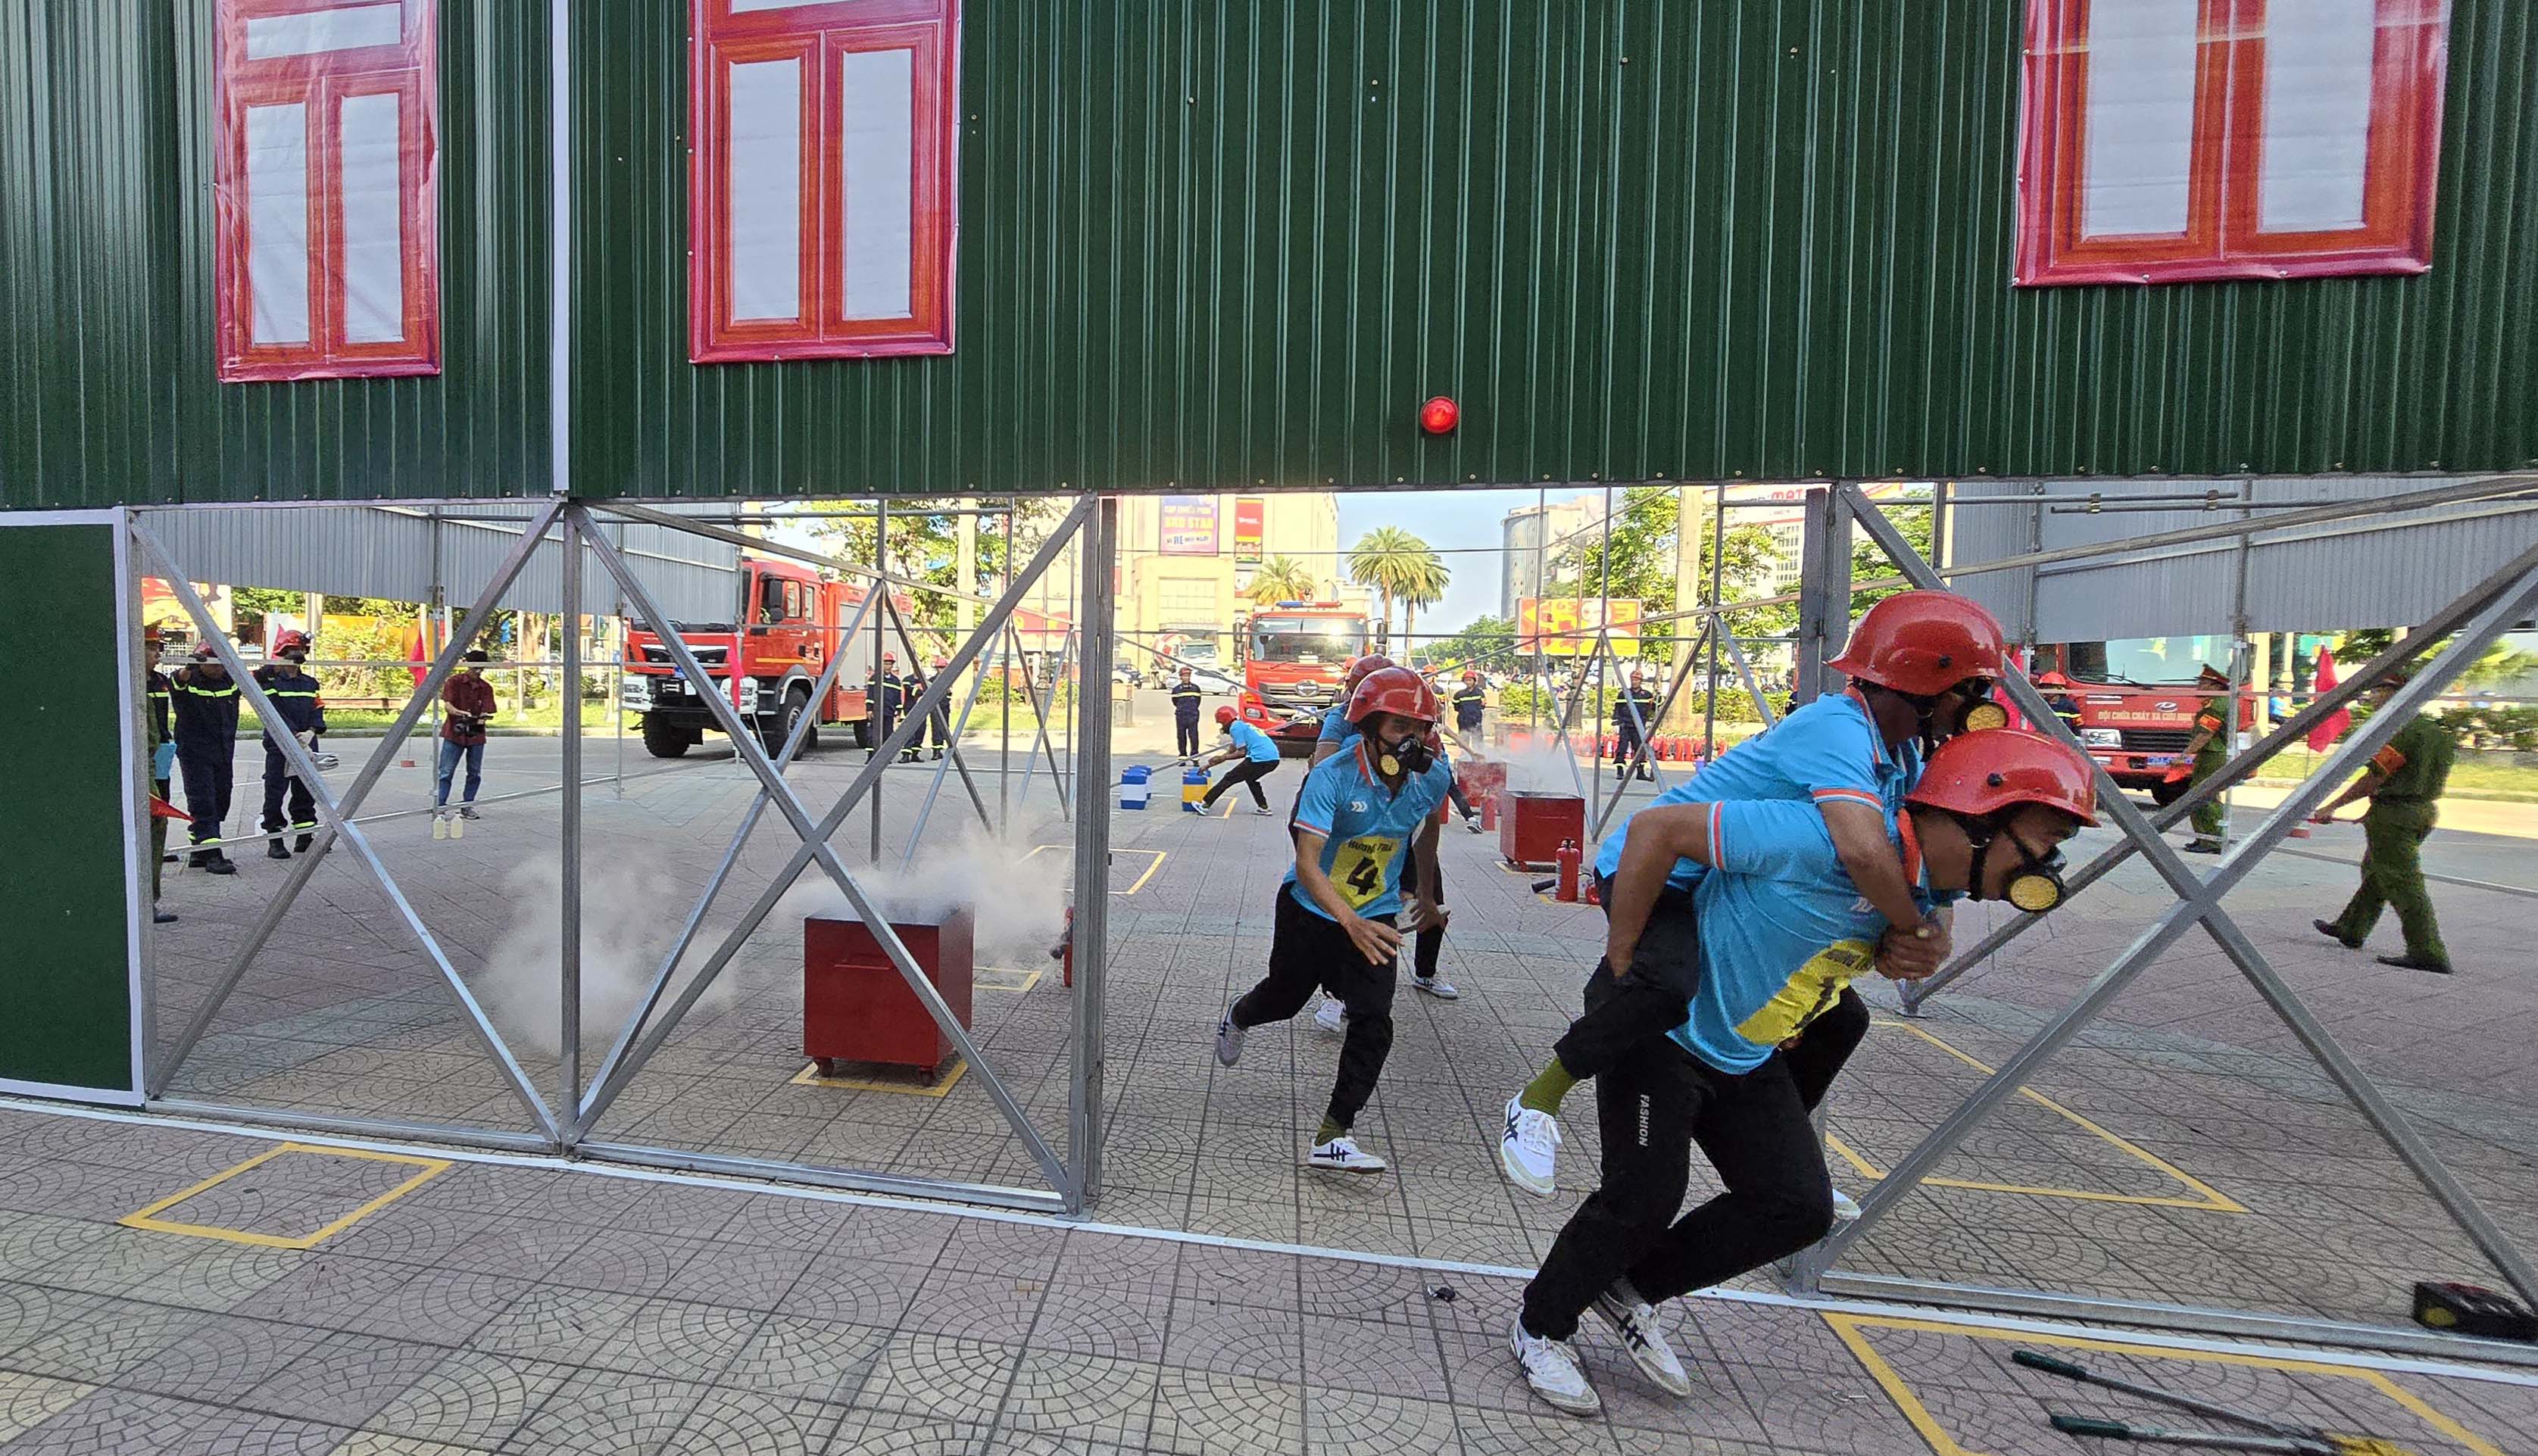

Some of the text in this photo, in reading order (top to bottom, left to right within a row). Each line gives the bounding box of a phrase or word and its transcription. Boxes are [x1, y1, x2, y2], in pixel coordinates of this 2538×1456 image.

[2132, 710, 2151, 720] CHÁY
[1346, 856, 1379, 896] 4
[1638, 1094, 1650, 1147] FASHION
